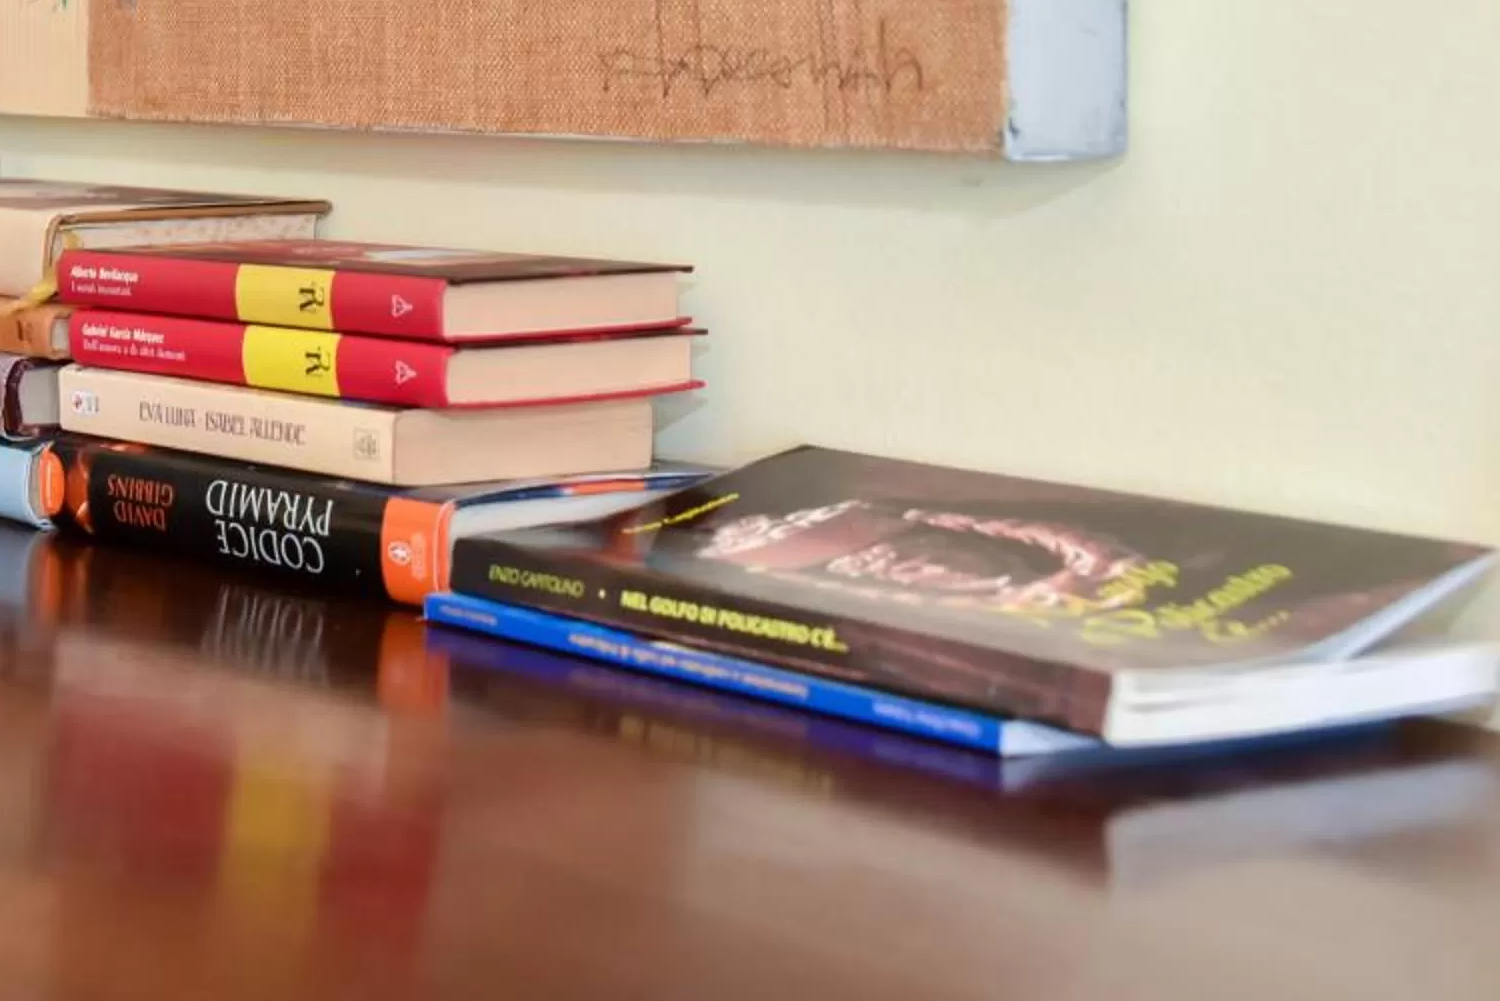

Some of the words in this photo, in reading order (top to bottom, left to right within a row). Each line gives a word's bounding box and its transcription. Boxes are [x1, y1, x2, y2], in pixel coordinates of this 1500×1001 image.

[70, 265, 97, 279] Alberto
[82, 323, 109, 338] Gabriel
[138, 402, 164, 424] EVA
[164, 404, 198, 428] LUNA
[204, 407, 245, 434] ISABEL
[250, 410, 308, 445] ALLENDE
[107, 473, 175, 507] GIBBINS
[113, 502, 167, 530] DAVID
[206, 479, 333, 538] PYRAMID
[216, 518, 324, 575] CODICE
[489, 563, 521, 584] ENZO
[620, 590, 649, 613] NEL
[650, 595, 699, 625] GOLFO
[699, 607, 717, 627] DI
[717, 611, 811, 646] POLICASTRO
